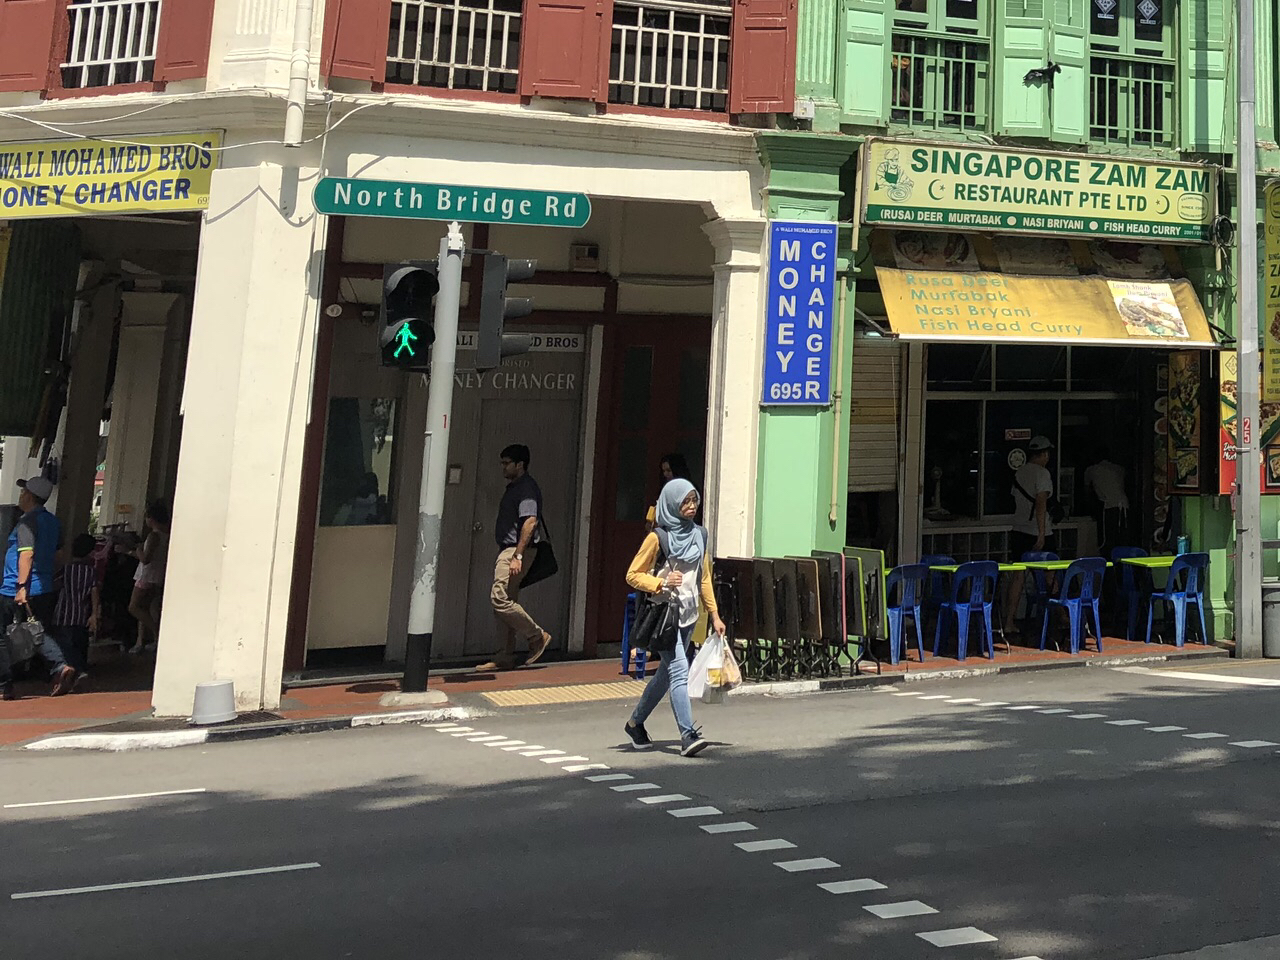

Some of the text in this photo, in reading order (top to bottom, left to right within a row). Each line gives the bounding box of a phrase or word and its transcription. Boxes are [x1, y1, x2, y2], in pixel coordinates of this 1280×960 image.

[49, 145, 151, 177] MOHAMED
[158, 141, 212, 171] BROS
[911, 149, 1210, 193] SINGAPORE ZAM ZAM
[0, 178, 191, 208] ONEY CHANGER
[333, 182, 577, 220] North Bridge Rd
[954, 183, 1147, 211] RESTAURANT PTE LTD
[880, 208, 915, 221] (RUSA)
[917, 210, 943, 222] DEER
[948, 213, 1001, 225] MURTABAK
[1022, 216, 1044, 228] NASI
[1047, 218, 1084, 230] BRIYANI
[1103, 221, 1125, 232] FISH
[1126, 223, 1150, 234] HEAD
[1152, 224, 1181, 236] CURRY
[906, 273, 954, 287] Rusa
[776, 239, 801, 373] MONEY
[914, 304, 1031, 318] Nasi Bryani
[804, 241, 827, 400] CHANGER
[919, 319, 1083, 336] Fish Head Curry
[546, 337, 579, 348] BROS
[420, 373, 575, 390] MNEY CHANGER
[770, 382, 802, 400] 695
